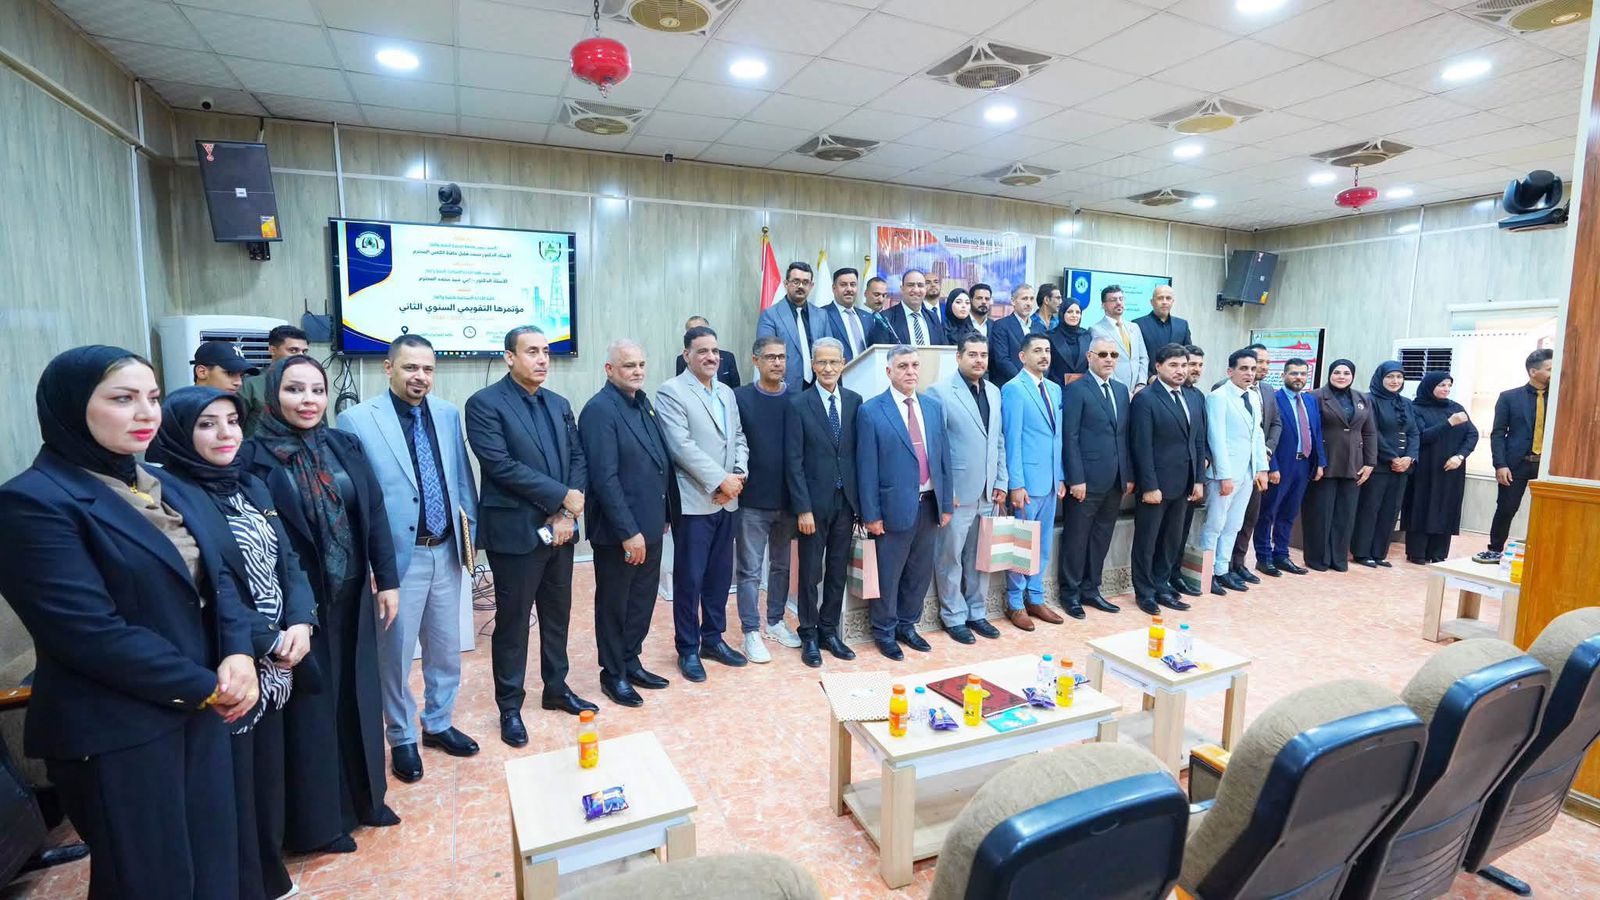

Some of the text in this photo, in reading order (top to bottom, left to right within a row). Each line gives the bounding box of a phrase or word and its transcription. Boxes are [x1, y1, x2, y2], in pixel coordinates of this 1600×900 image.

[398, 302, 525, 315] مؤتمرها التقويمي السنوي الثاني
